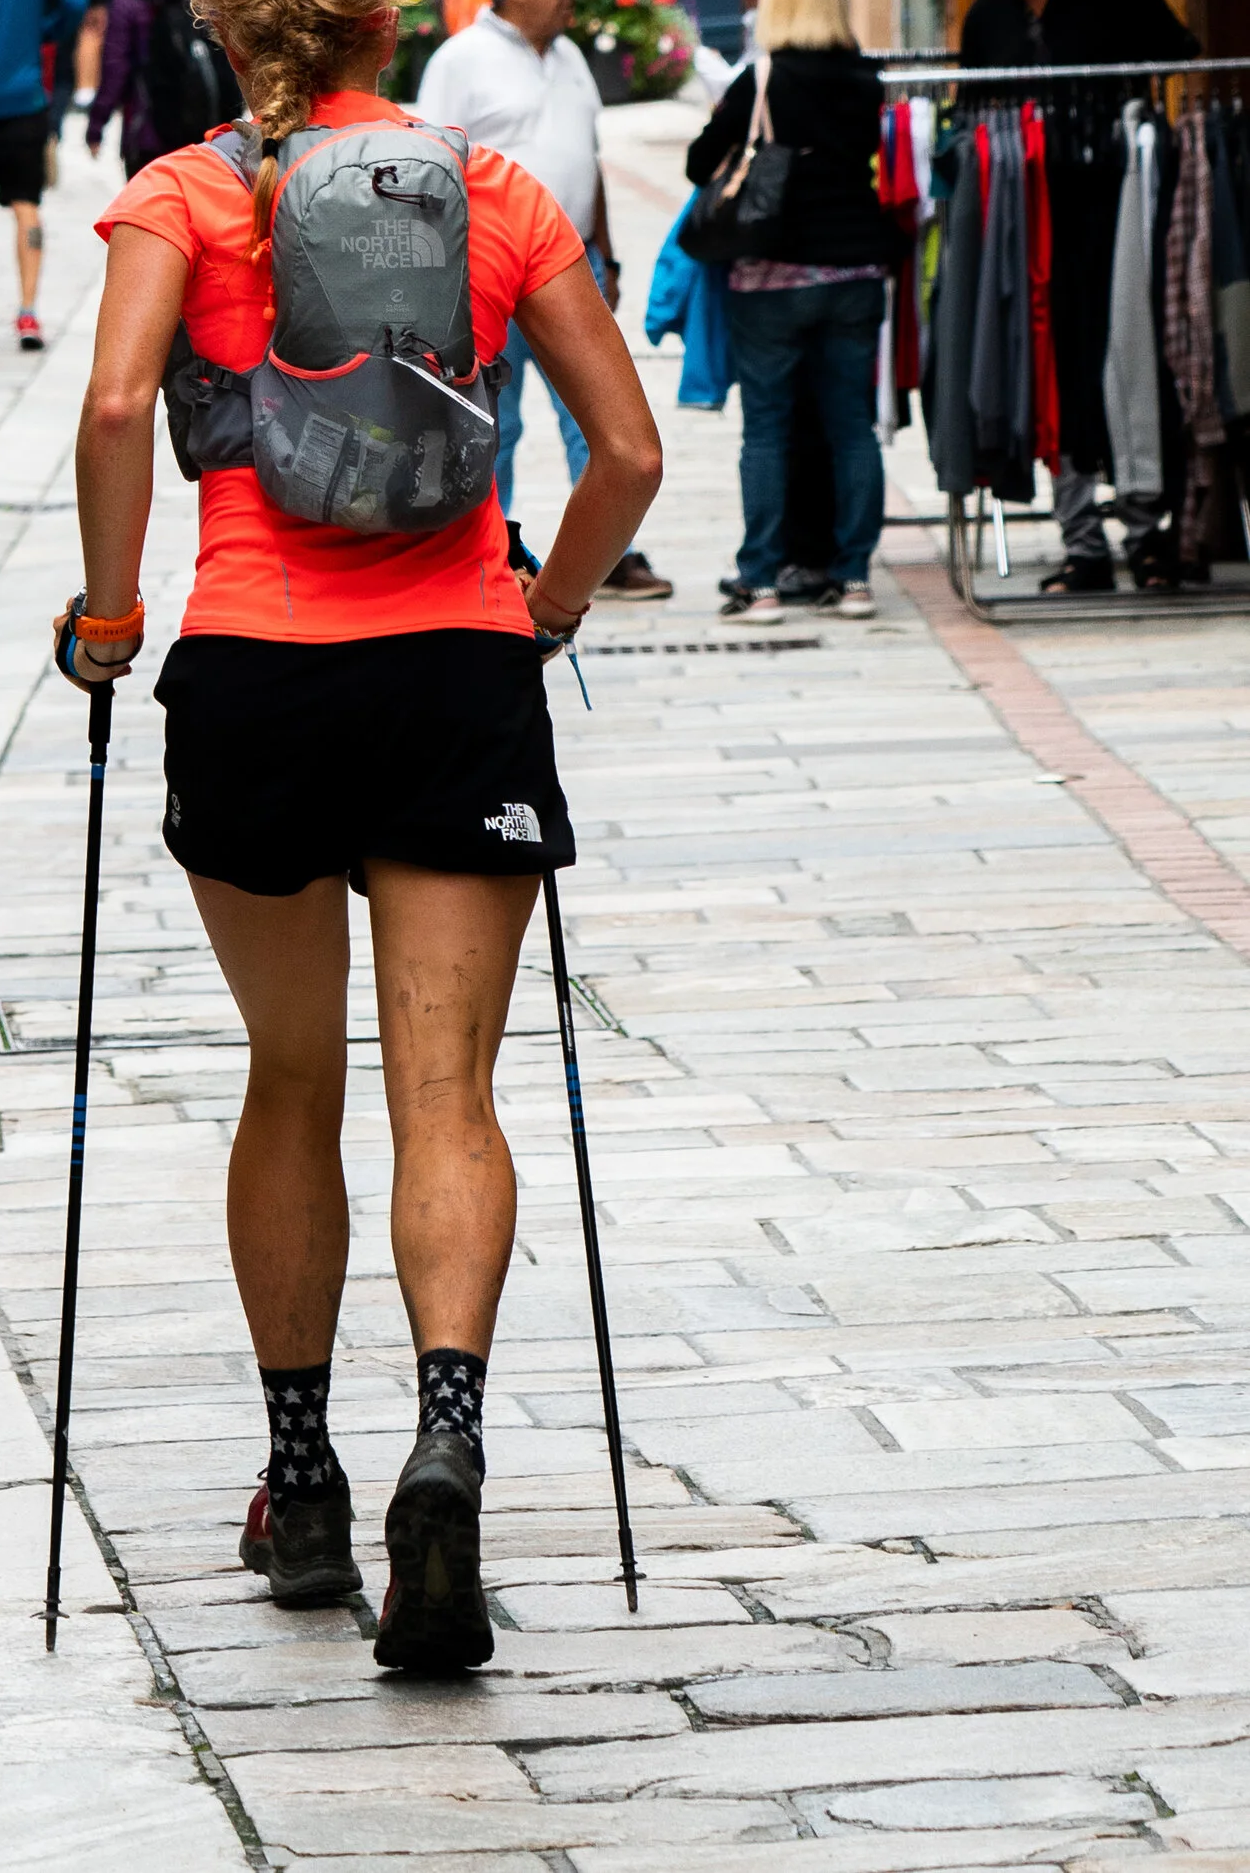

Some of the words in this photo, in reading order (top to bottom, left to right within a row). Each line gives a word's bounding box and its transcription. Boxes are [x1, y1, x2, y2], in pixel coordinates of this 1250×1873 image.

[371, 219, 410, 236] THE
[341, 235, 410, 253] NORTH
[362, 252, 411, 268] FACE
[502, 803, 525, 816] THE
[484, 816, 526, 830] NORTH
[501, 828, 528, 841] FACE
